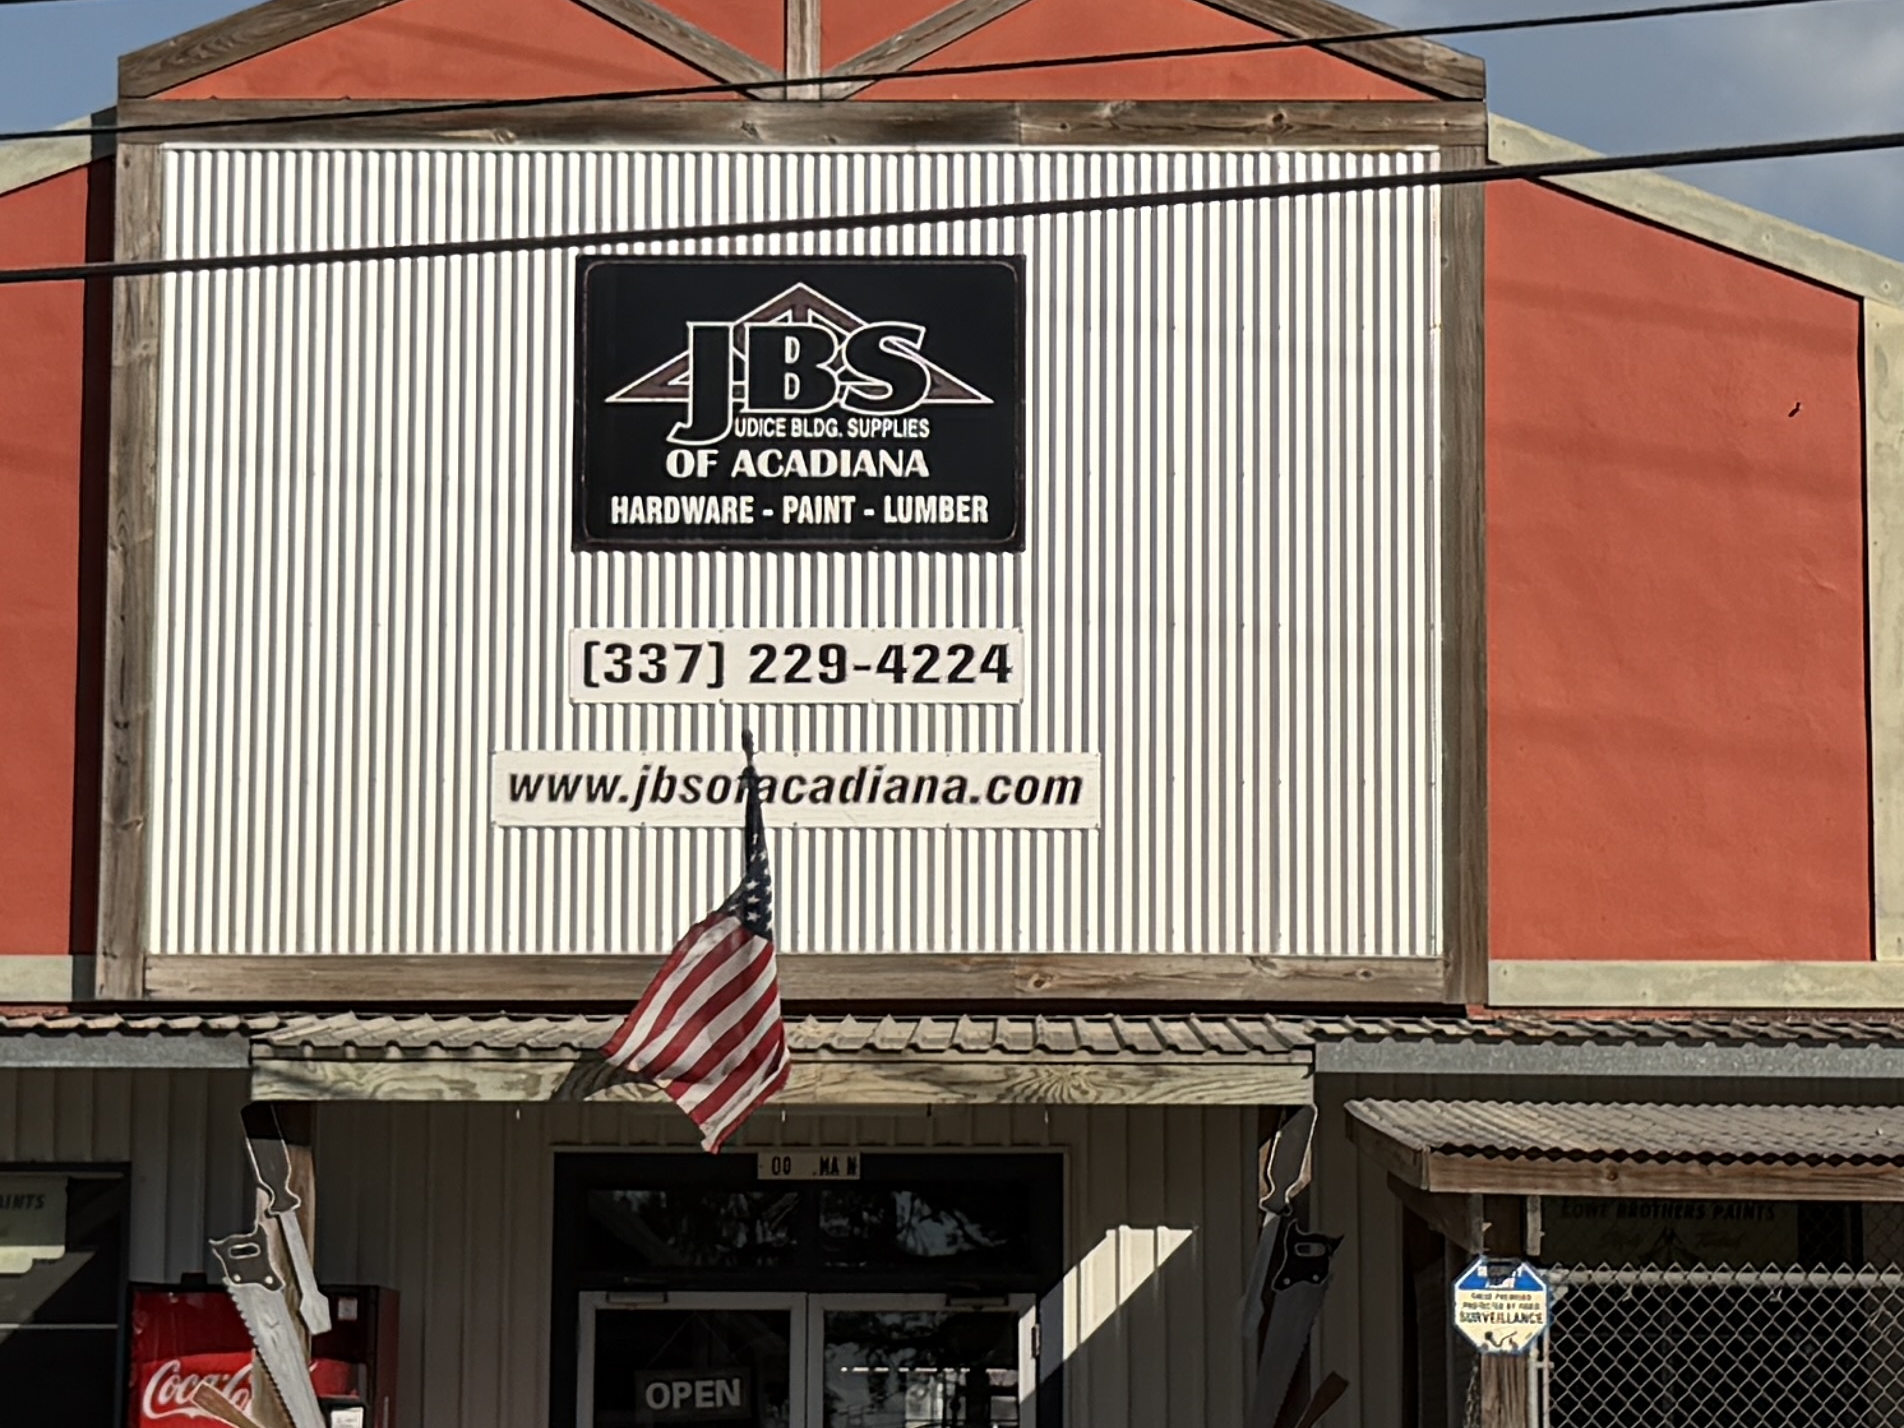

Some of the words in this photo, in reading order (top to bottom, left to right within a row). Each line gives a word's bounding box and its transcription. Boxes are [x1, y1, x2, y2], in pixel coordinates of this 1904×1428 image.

[666, 321, 931, 445] JBS
[791, 418, 842, 438] BLDG.
[847, 418, 930, 438] SUPPLIES
[666, 448, 719, 478] OF
[731, 448, 930, 478] ACADIANA
[611, 495, 754, 524] HARDWARE
[782, 495, 857, 524] PAINT
[884, 495, 989, 524] LUMBER
[748, 642, 1013, 685] 229-4224
[1713, 1204, 1776, 1221] PAINTS
[645, 1378, 742, 1410] OPEN
